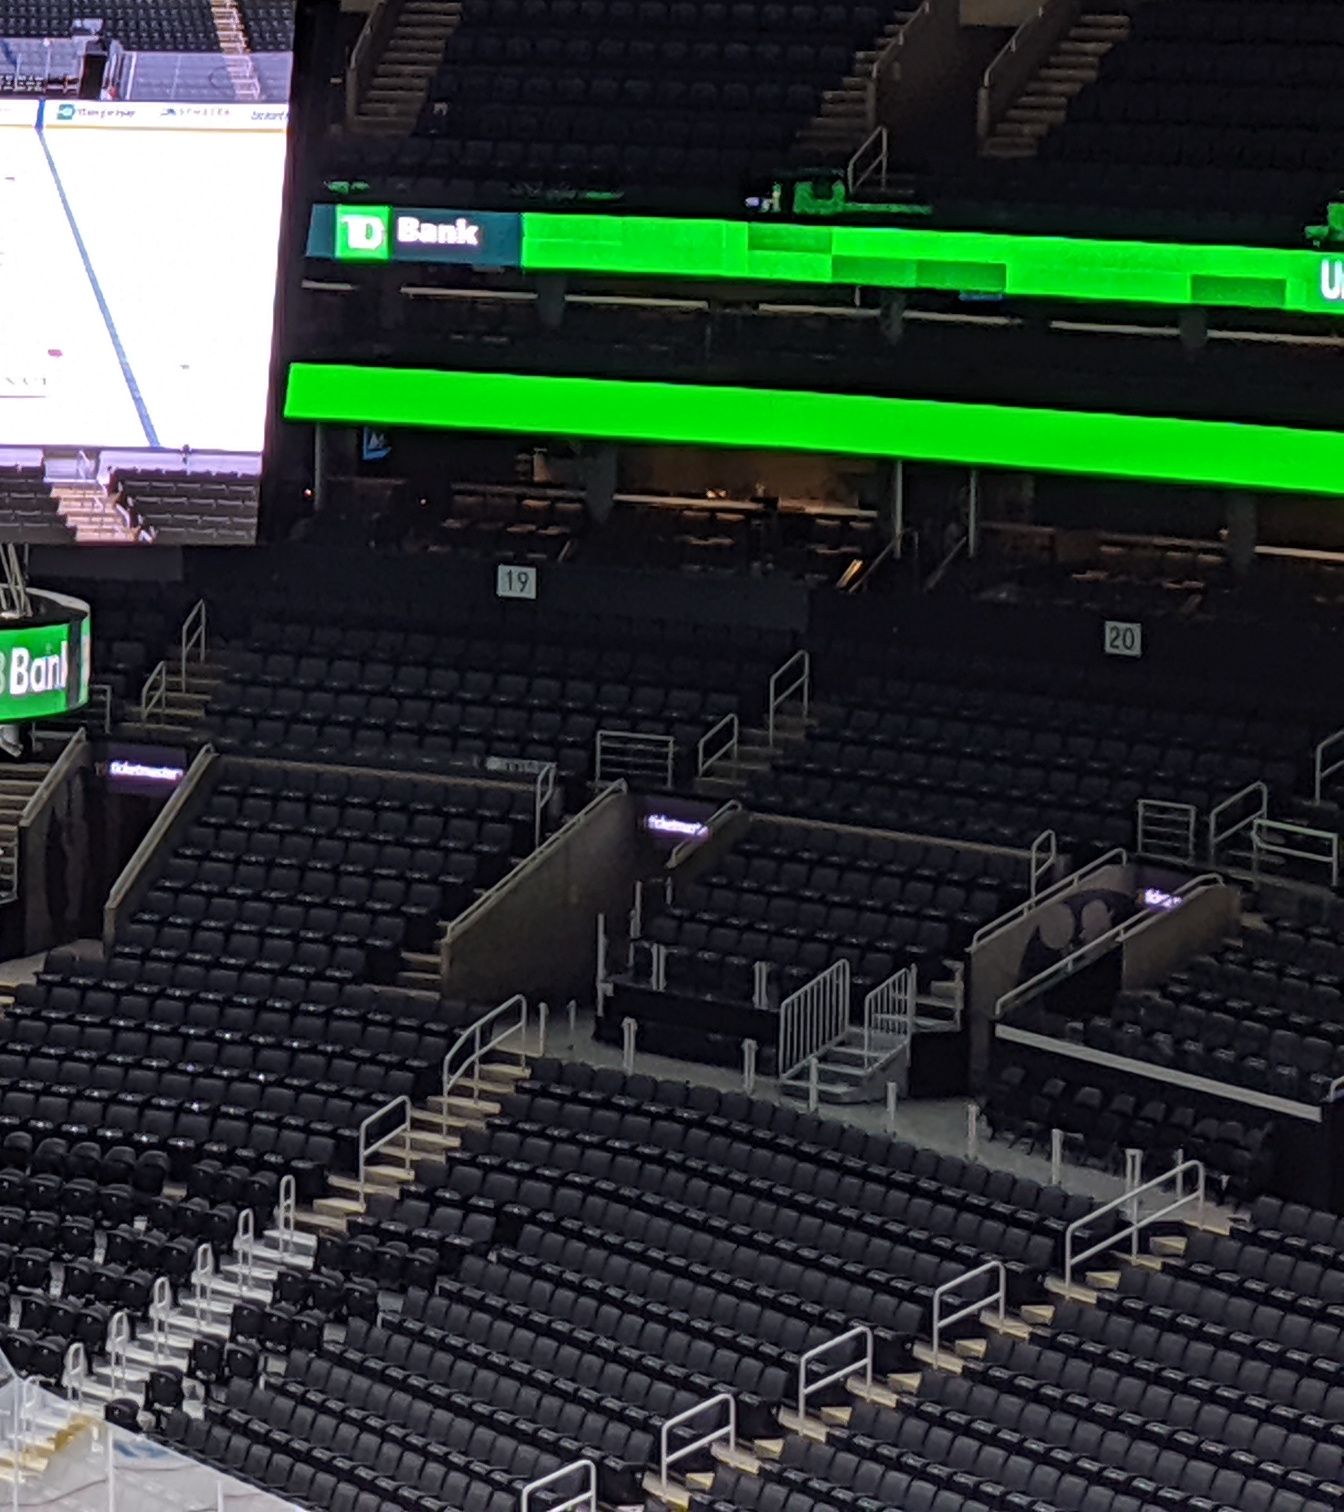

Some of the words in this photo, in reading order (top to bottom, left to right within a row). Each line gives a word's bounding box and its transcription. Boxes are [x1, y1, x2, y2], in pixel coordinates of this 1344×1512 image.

[396, 216, 479, 245] Bank
[507, 569, 529, 593] 19
[1109, 625, 1135, 650] 20
